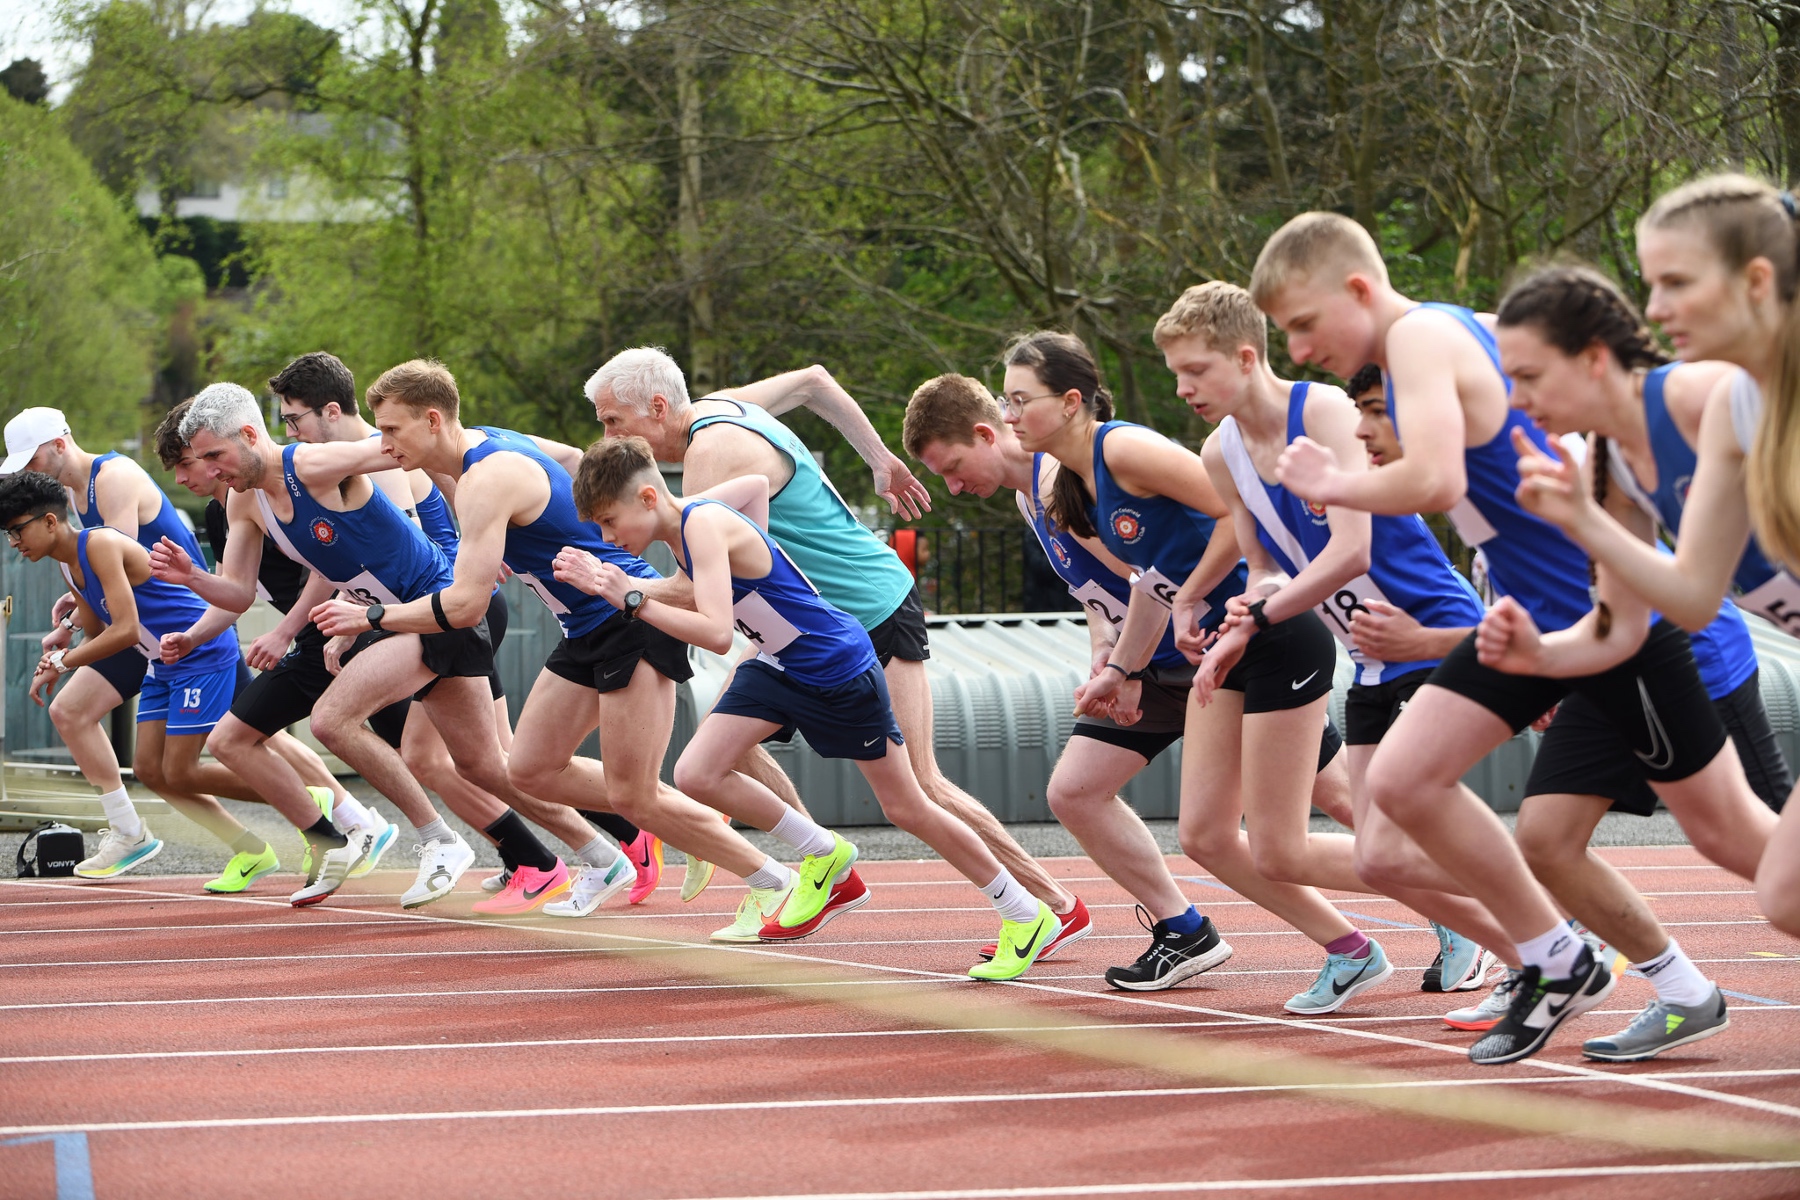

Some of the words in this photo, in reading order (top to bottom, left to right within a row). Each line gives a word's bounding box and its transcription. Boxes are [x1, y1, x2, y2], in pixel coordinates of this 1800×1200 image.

[1322, 589, 1371, 635] 18
[183, 687, 202, 708] 13
[46, 860, 76, 869] VONYX
